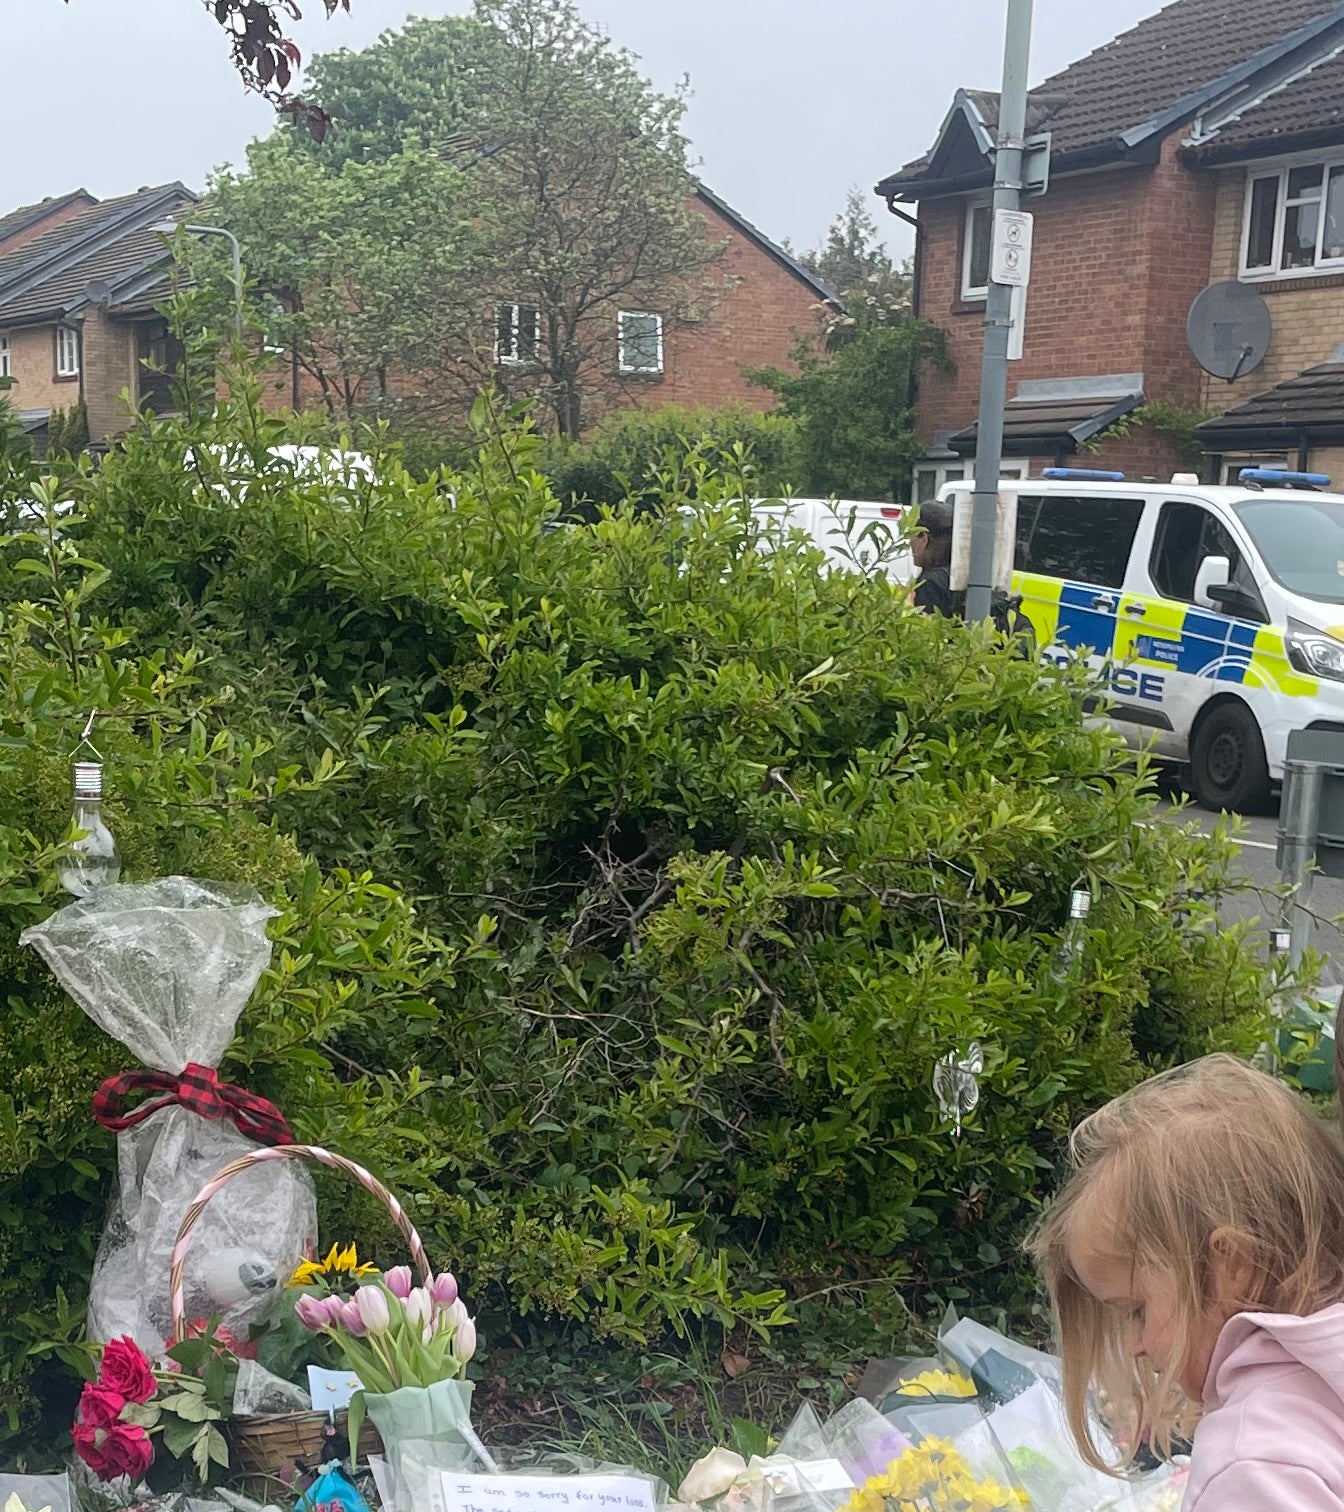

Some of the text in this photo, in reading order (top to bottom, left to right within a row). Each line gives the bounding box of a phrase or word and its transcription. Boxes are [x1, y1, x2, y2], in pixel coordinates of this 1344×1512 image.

[457, 1485, 473, 1494] I
[514, 1489, 531, 1498] so
[537, 1490, 569, 1504] sorry
[575, 1490, 593, 1501] for
[597, 1493, 622, 1506] your
